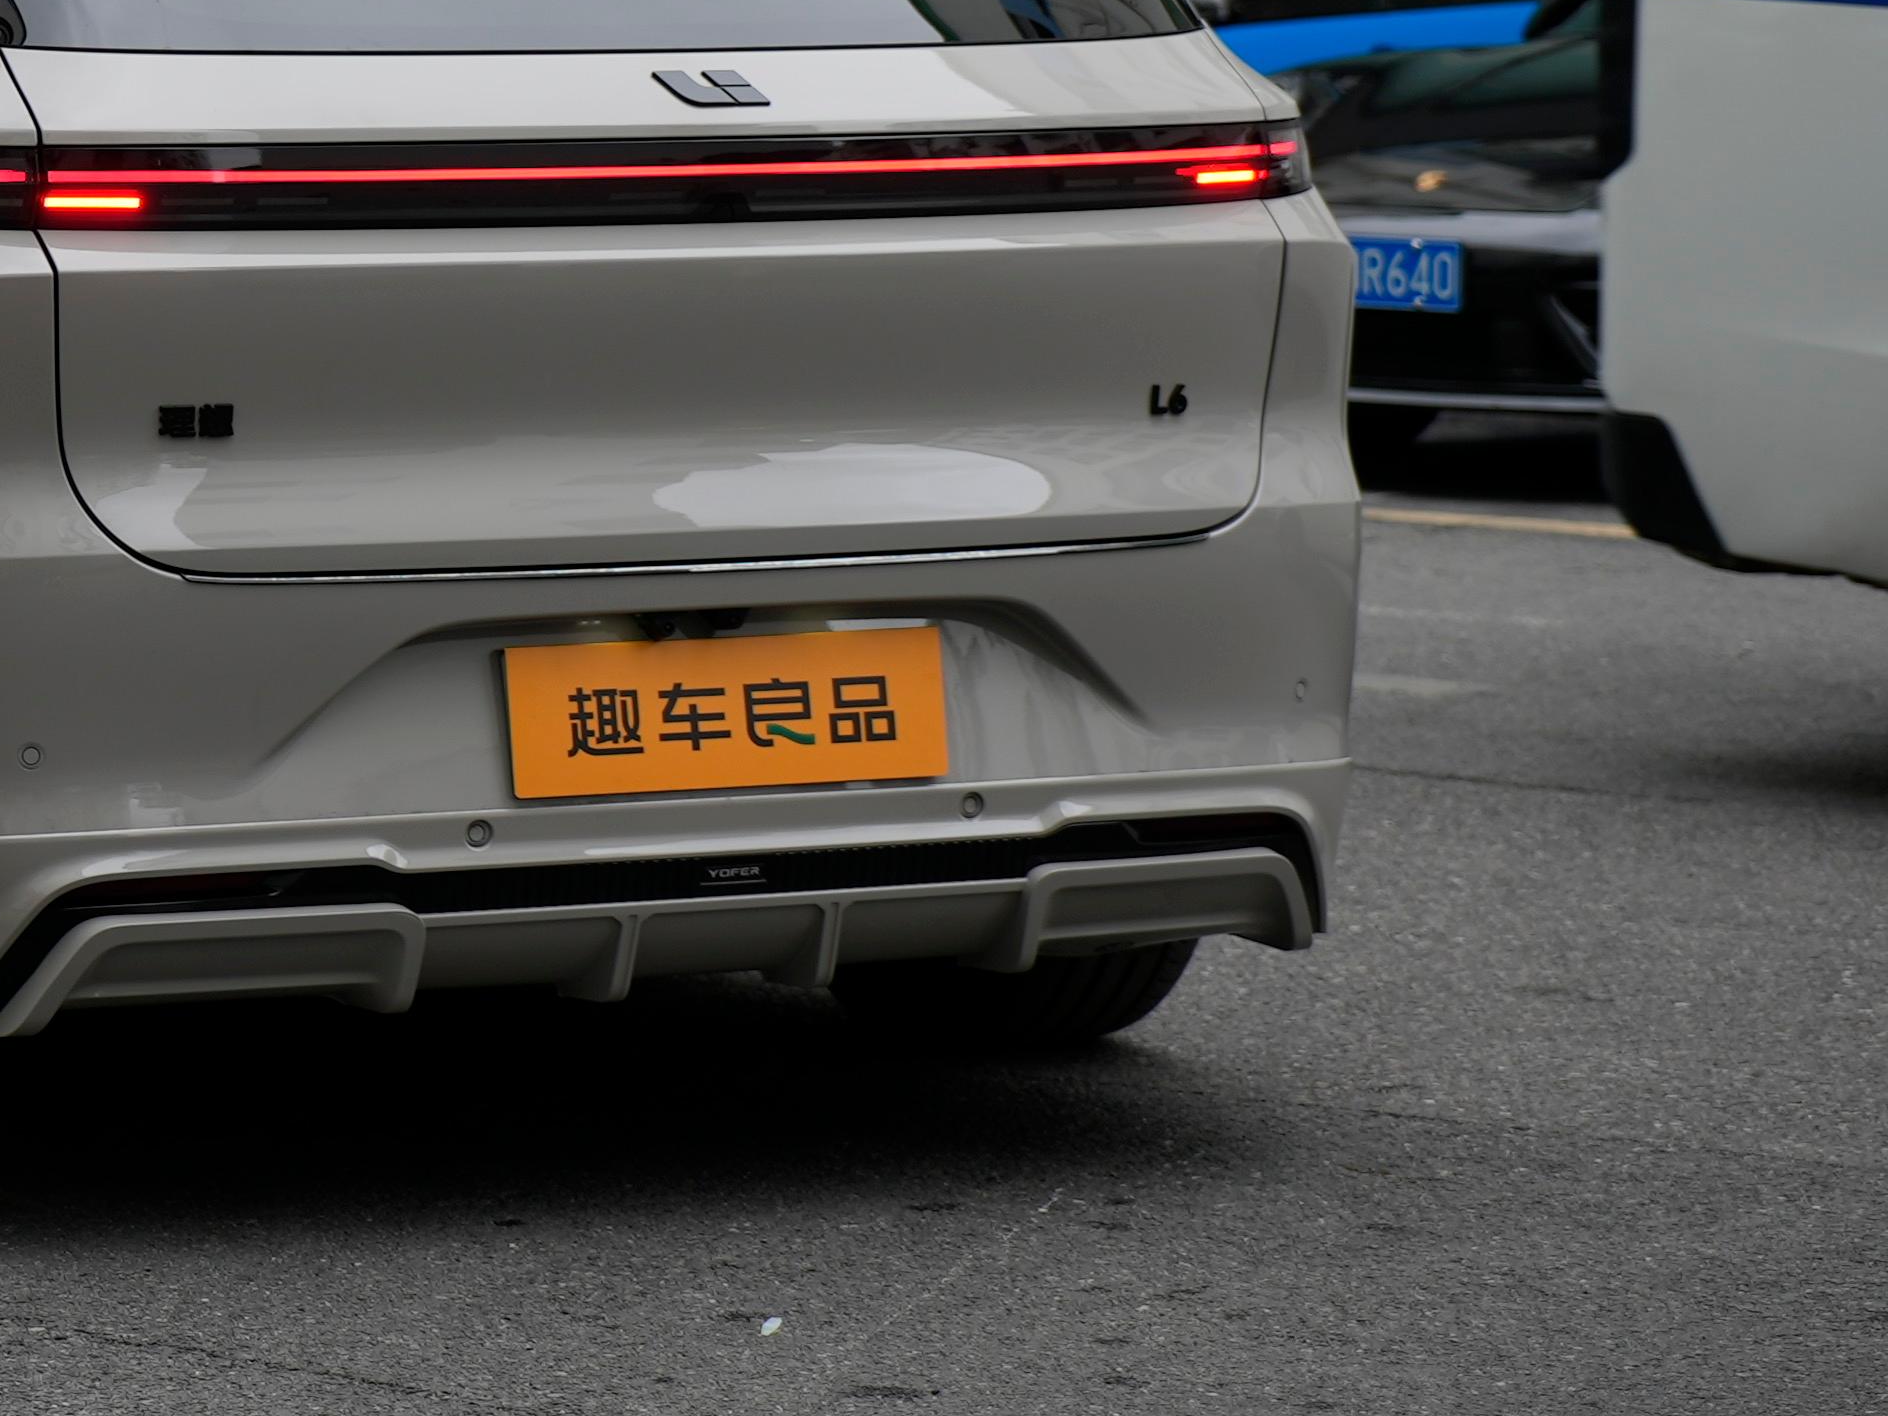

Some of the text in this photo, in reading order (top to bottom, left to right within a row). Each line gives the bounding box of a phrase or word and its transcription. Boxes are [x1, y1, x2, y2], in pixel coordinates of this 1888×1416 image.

[1150, 384, 1188, 415] L6
[567, 675, 897, 758] 趣车良品
[708, 866, 761, 879] YOFER
